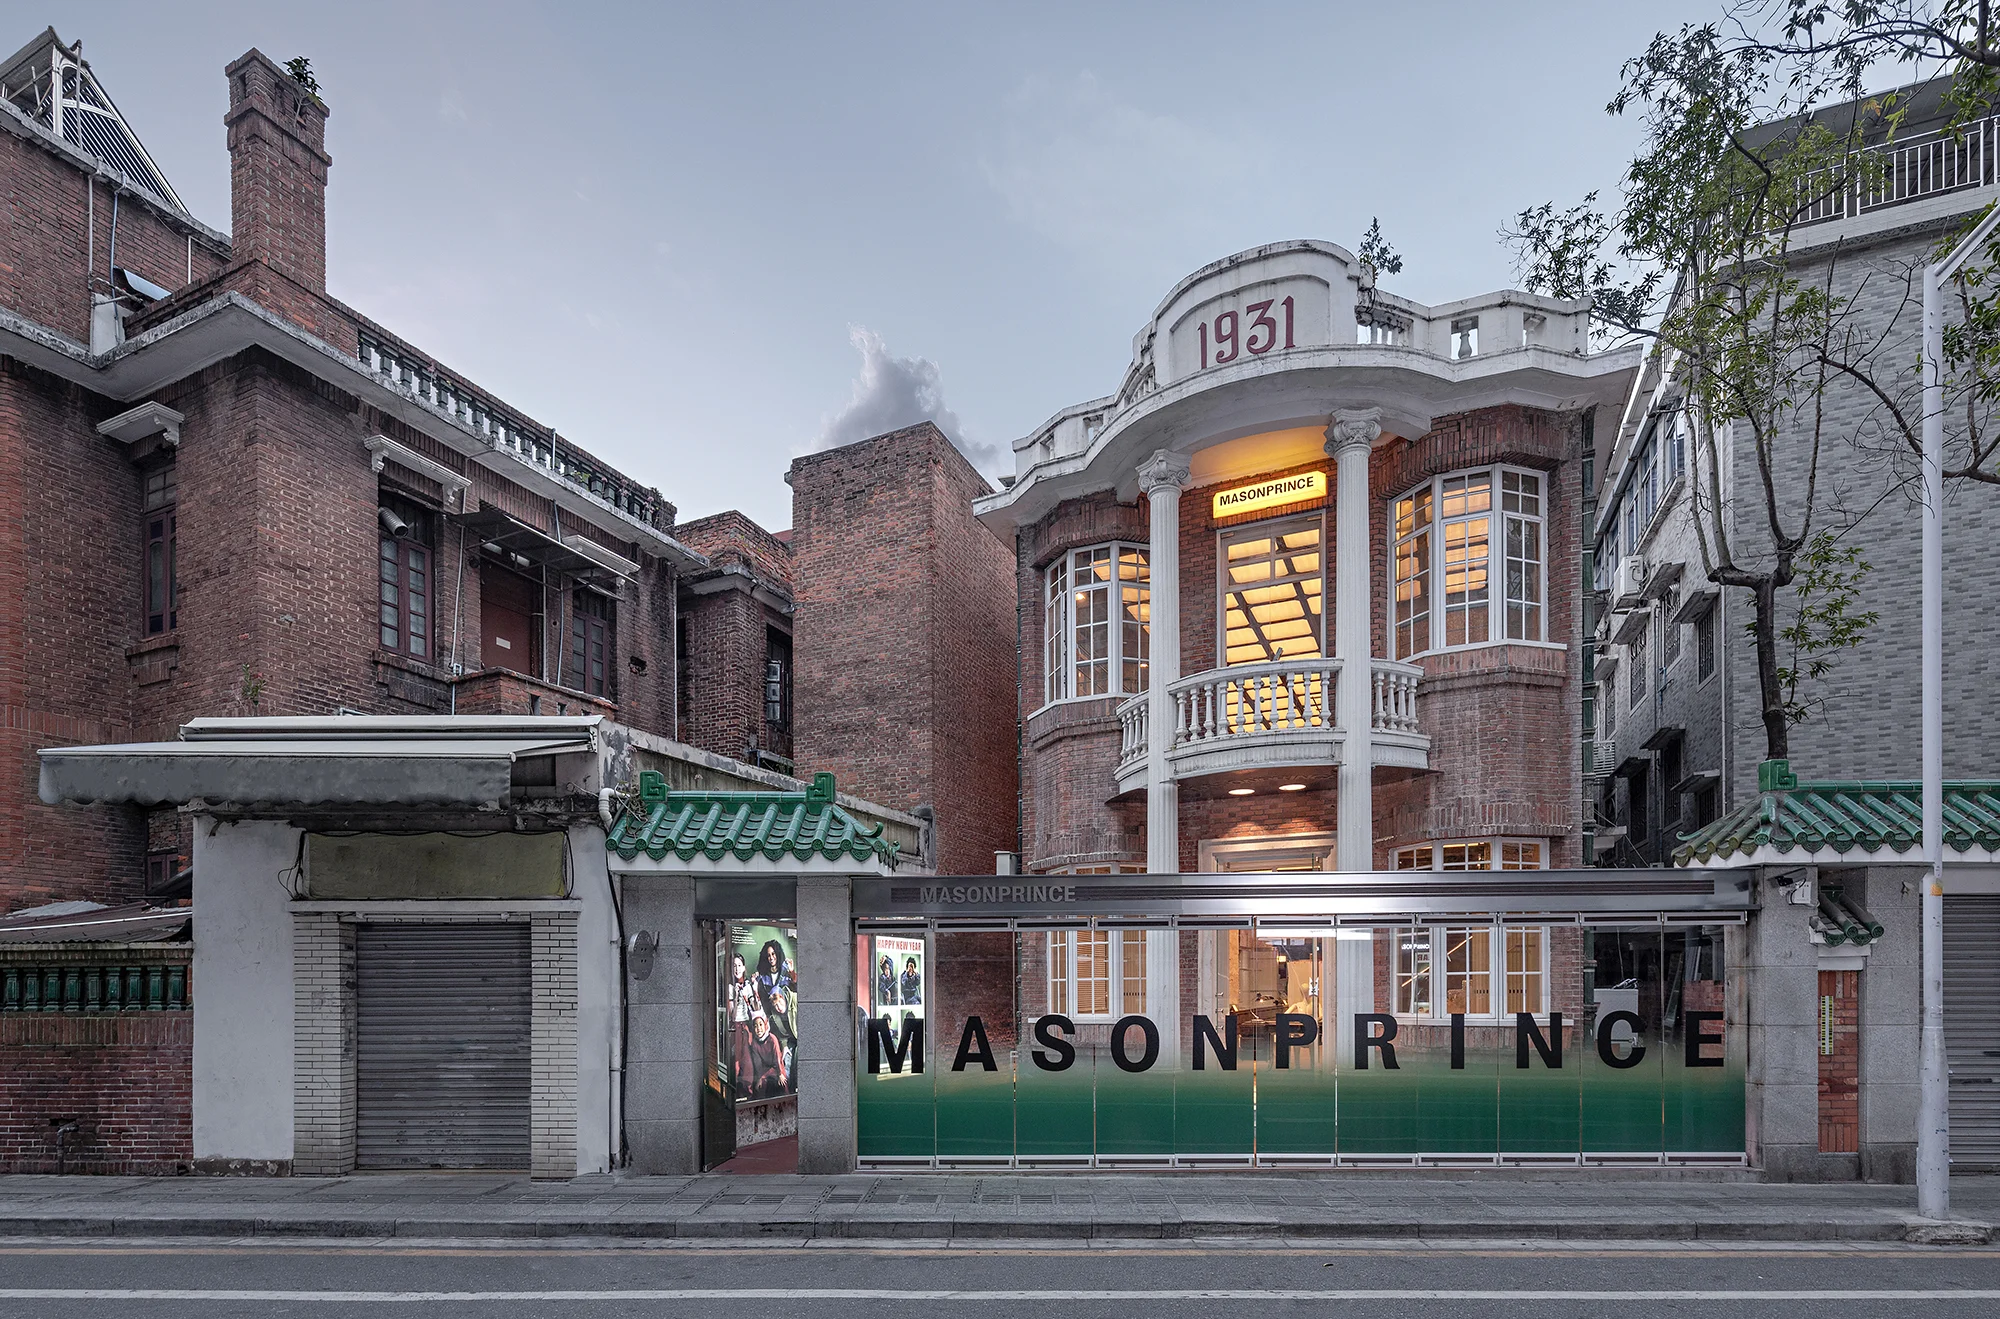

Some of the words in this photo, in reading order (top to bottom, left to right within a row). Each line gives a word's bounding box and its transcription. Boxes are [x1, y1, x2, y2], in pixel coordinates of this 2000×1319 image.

[1197, 295, 1295, 370] 1931
[1219, 476, 1314, 506] MASONPRINCE
[919, 885, 1076, 903] MASONPRINCE
[877, 939, 895, 949] HAPPY
[896, 940, 908, 950] NEW
[909, 942, 921, 951] YEAR
[868, 1010, 1724, 1074] MASONPRINCE
